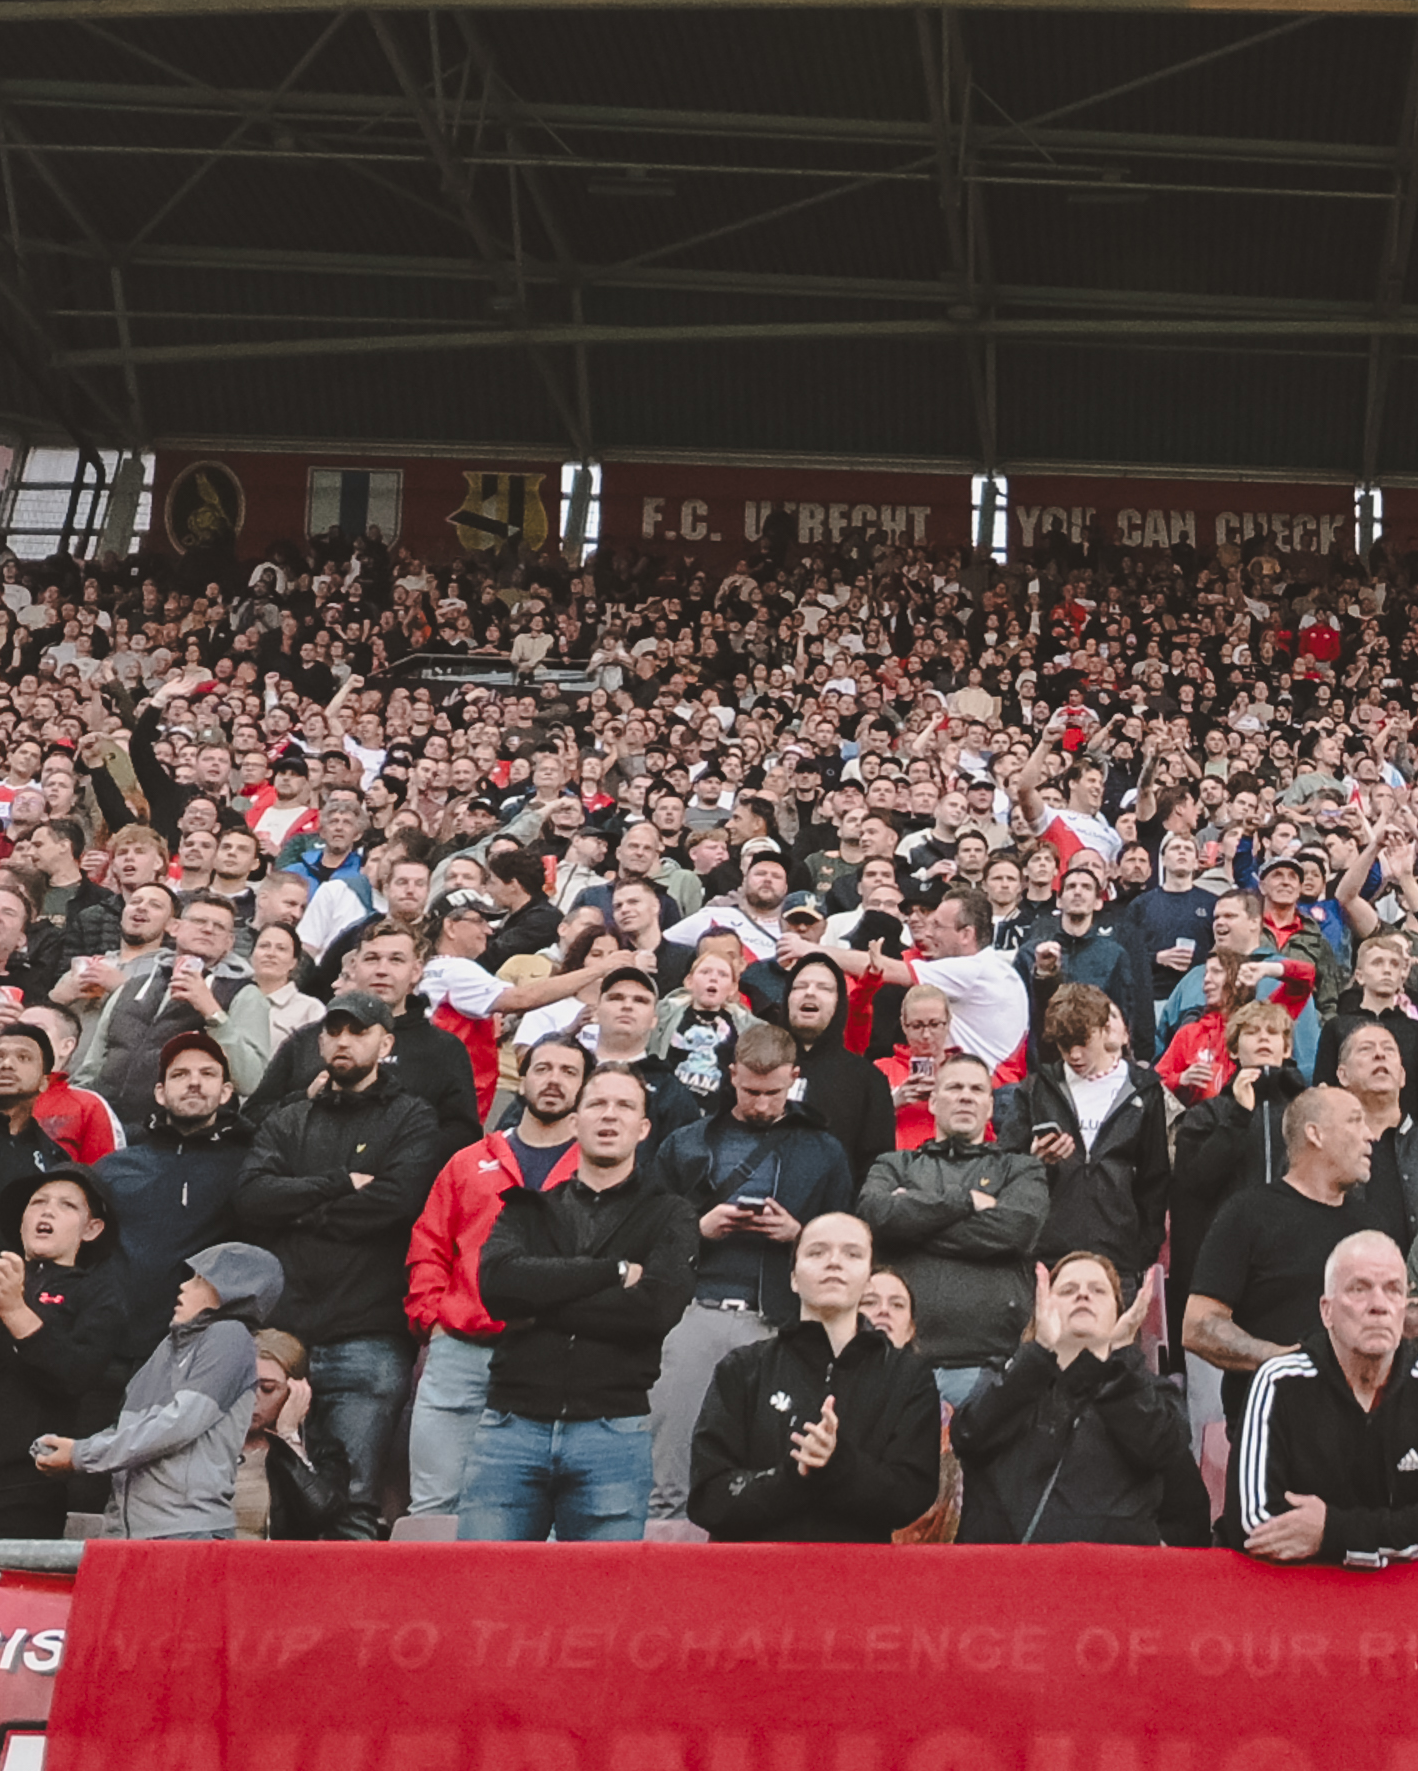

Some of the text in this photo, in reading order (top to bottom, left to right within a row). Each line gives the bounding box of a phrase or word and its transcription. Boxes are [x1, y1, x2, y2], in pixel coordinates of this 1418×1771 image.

[641, 496, 931, 546] F.C. URECHT
[1117, 507, 1197, 550] CAN
